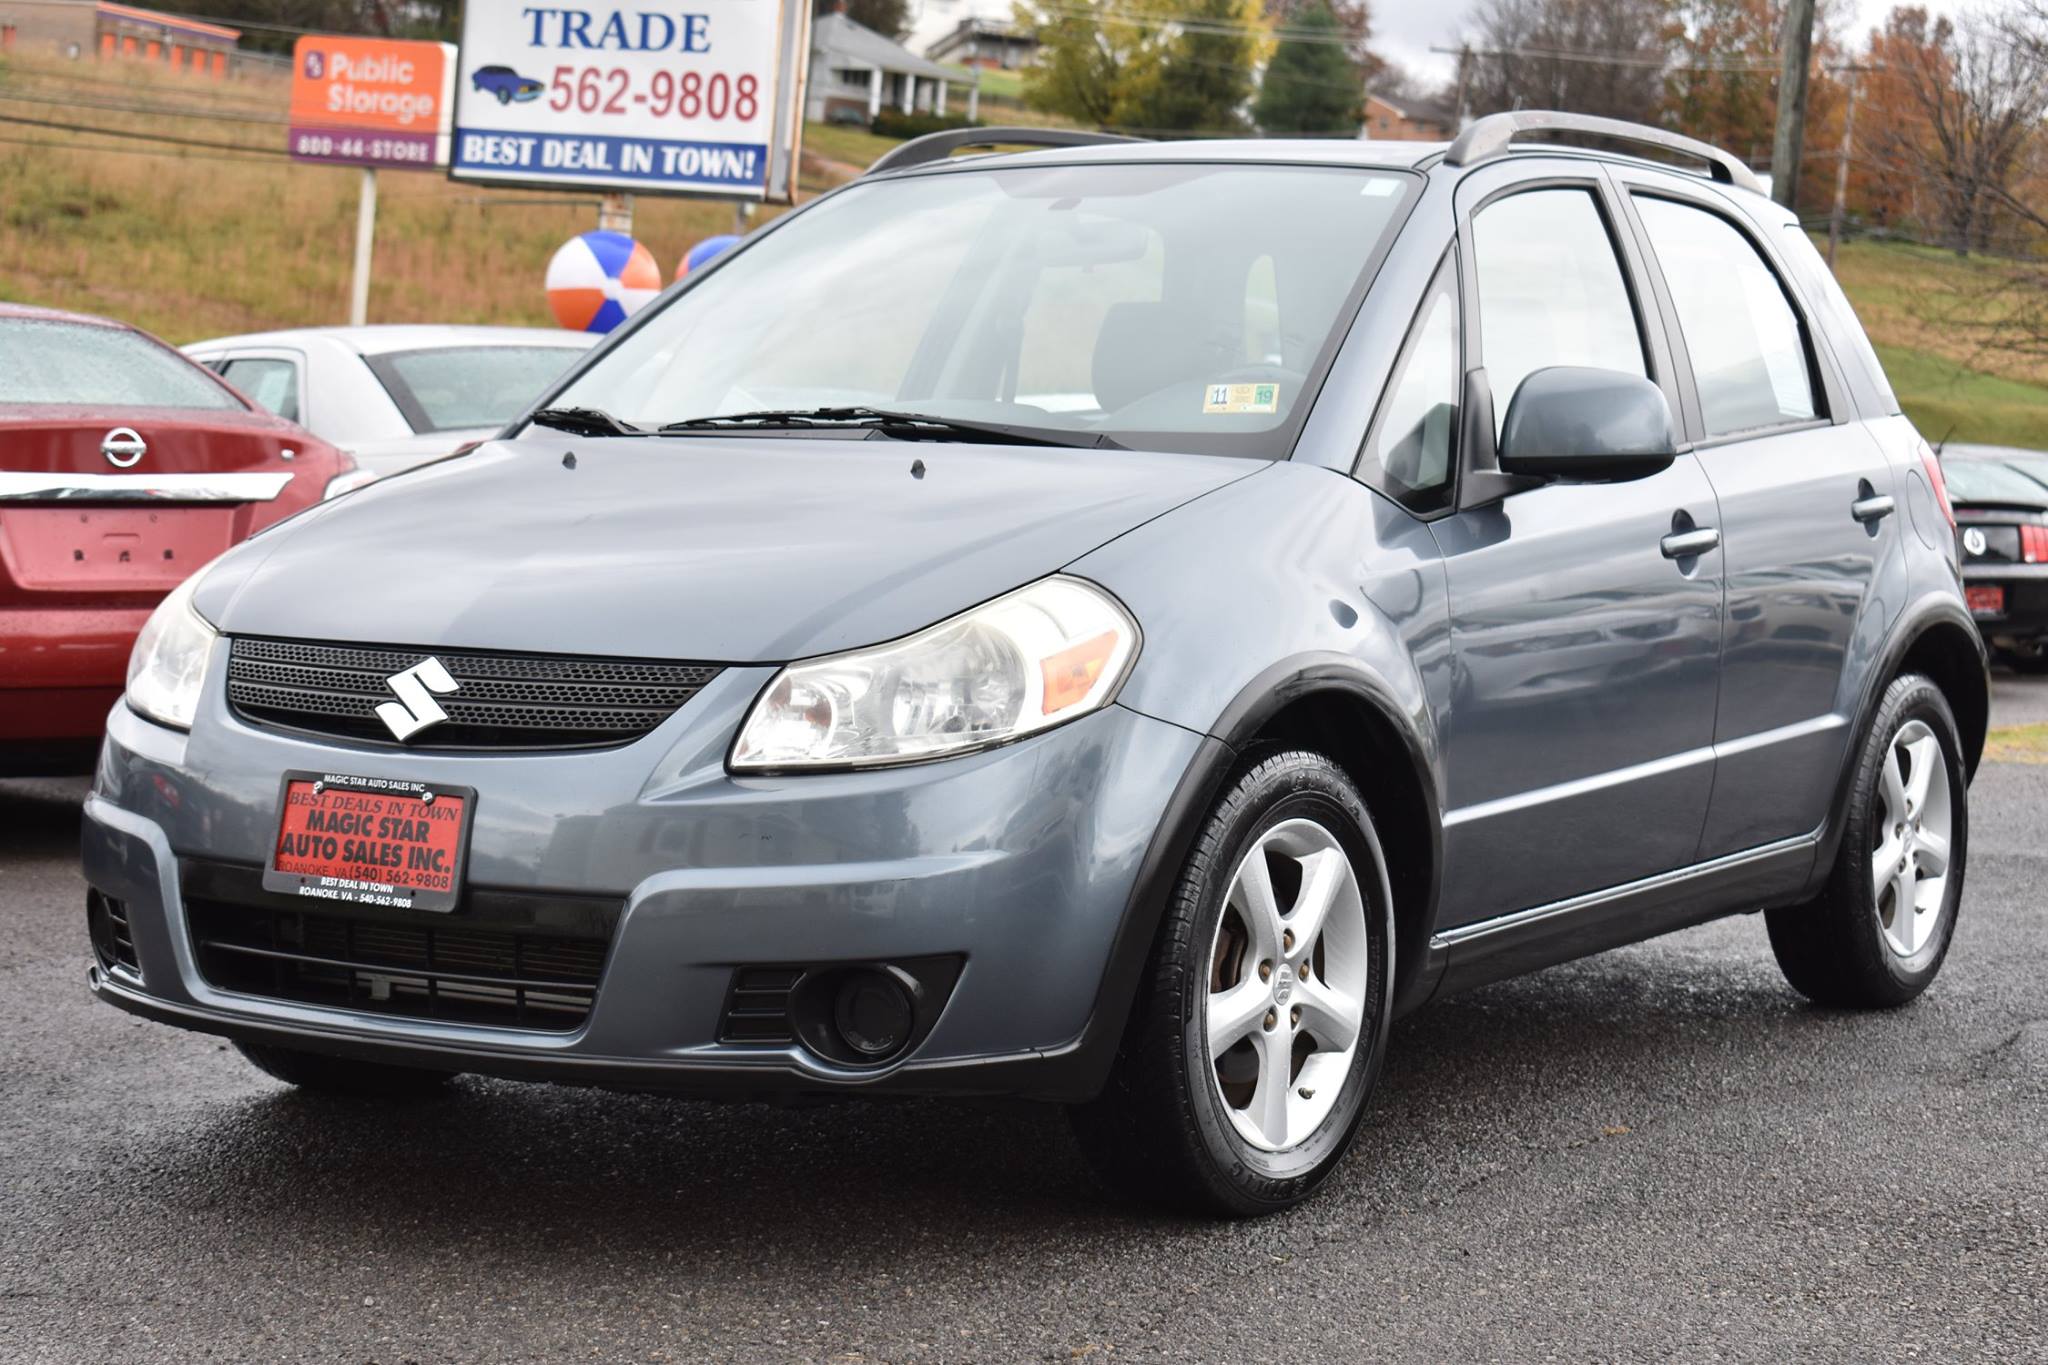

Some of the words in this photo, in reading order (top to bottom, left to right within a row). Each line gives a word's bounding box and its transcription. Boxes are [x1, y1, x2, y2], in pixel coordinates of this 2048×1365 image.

[524, 8, 712, 53] TRADE
[330, 52, 414, 84] Public
[328, 83, 433, 124] Storage
[549, 65, 759, 122] 562-9808
[463, 134, 537, 166] BEST
[542, 139, 612, 171] DEAL
[620, 143, 655, 174] IN
[661, 146, 756, 180] TOWN!
[324, 774, 349, 785] MAGIC
[350, 776, 367, 786] STAR
[368, 778, 388, 788] AUTO
[388, 780, 409, 791] SALES
[410, 783, 425, 792] INC
[289, 791, 330, 807] BEST
[331, 795, 384, 814] DEALS
[388, 801, 406, 816] IN
[410, 803, 459, 821] TOWN
[307, 809, 374, 837] MAGIC
[377, 817, 430, 843] STAR
[281, 833, 338, 859] AUTO
[341, 839, 403, 868] SALES
[408, 846, 451, 874] INC.
[320, 876, 338, 887] BEST
[339, 880, 358, 890] DEAL
[359, 882, 369, 891] IN
[370, 883, 394, 894] TOWN
[349, 865, 383, 883] (540)
[386, 871, 449, 889] 562-9808
[341, 891, 353, 901] VA
[359, 893, 412, 909] 540-562-9808
